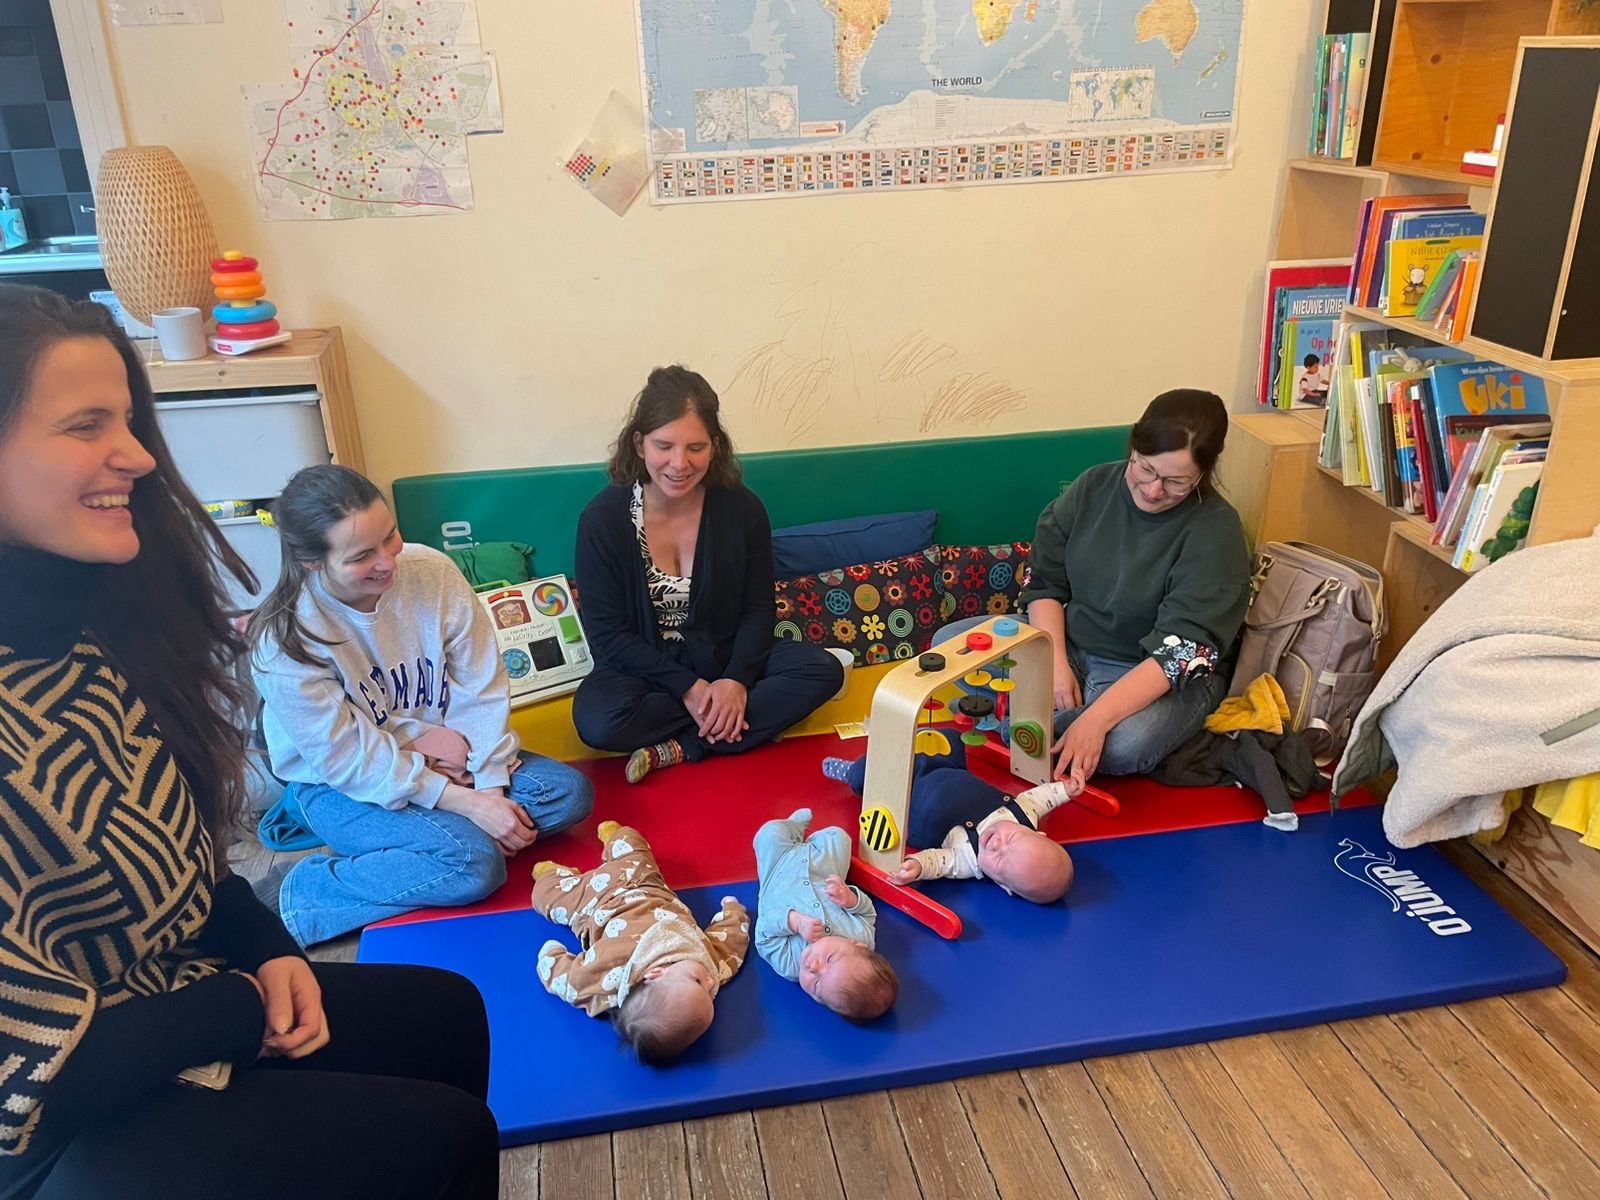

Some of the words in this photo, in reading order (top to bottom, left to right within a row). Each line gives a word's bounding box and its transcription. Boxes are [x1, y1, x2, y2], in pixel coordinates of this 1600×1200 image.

[931, 78, 948, 87] THE
[950, 76, 982, 87] WORLD
[1293, 299, 1323, 316] NIEUWE
[1311, 336, 1324, 351] Op
[1459, 374, 1526, 416] Uki
